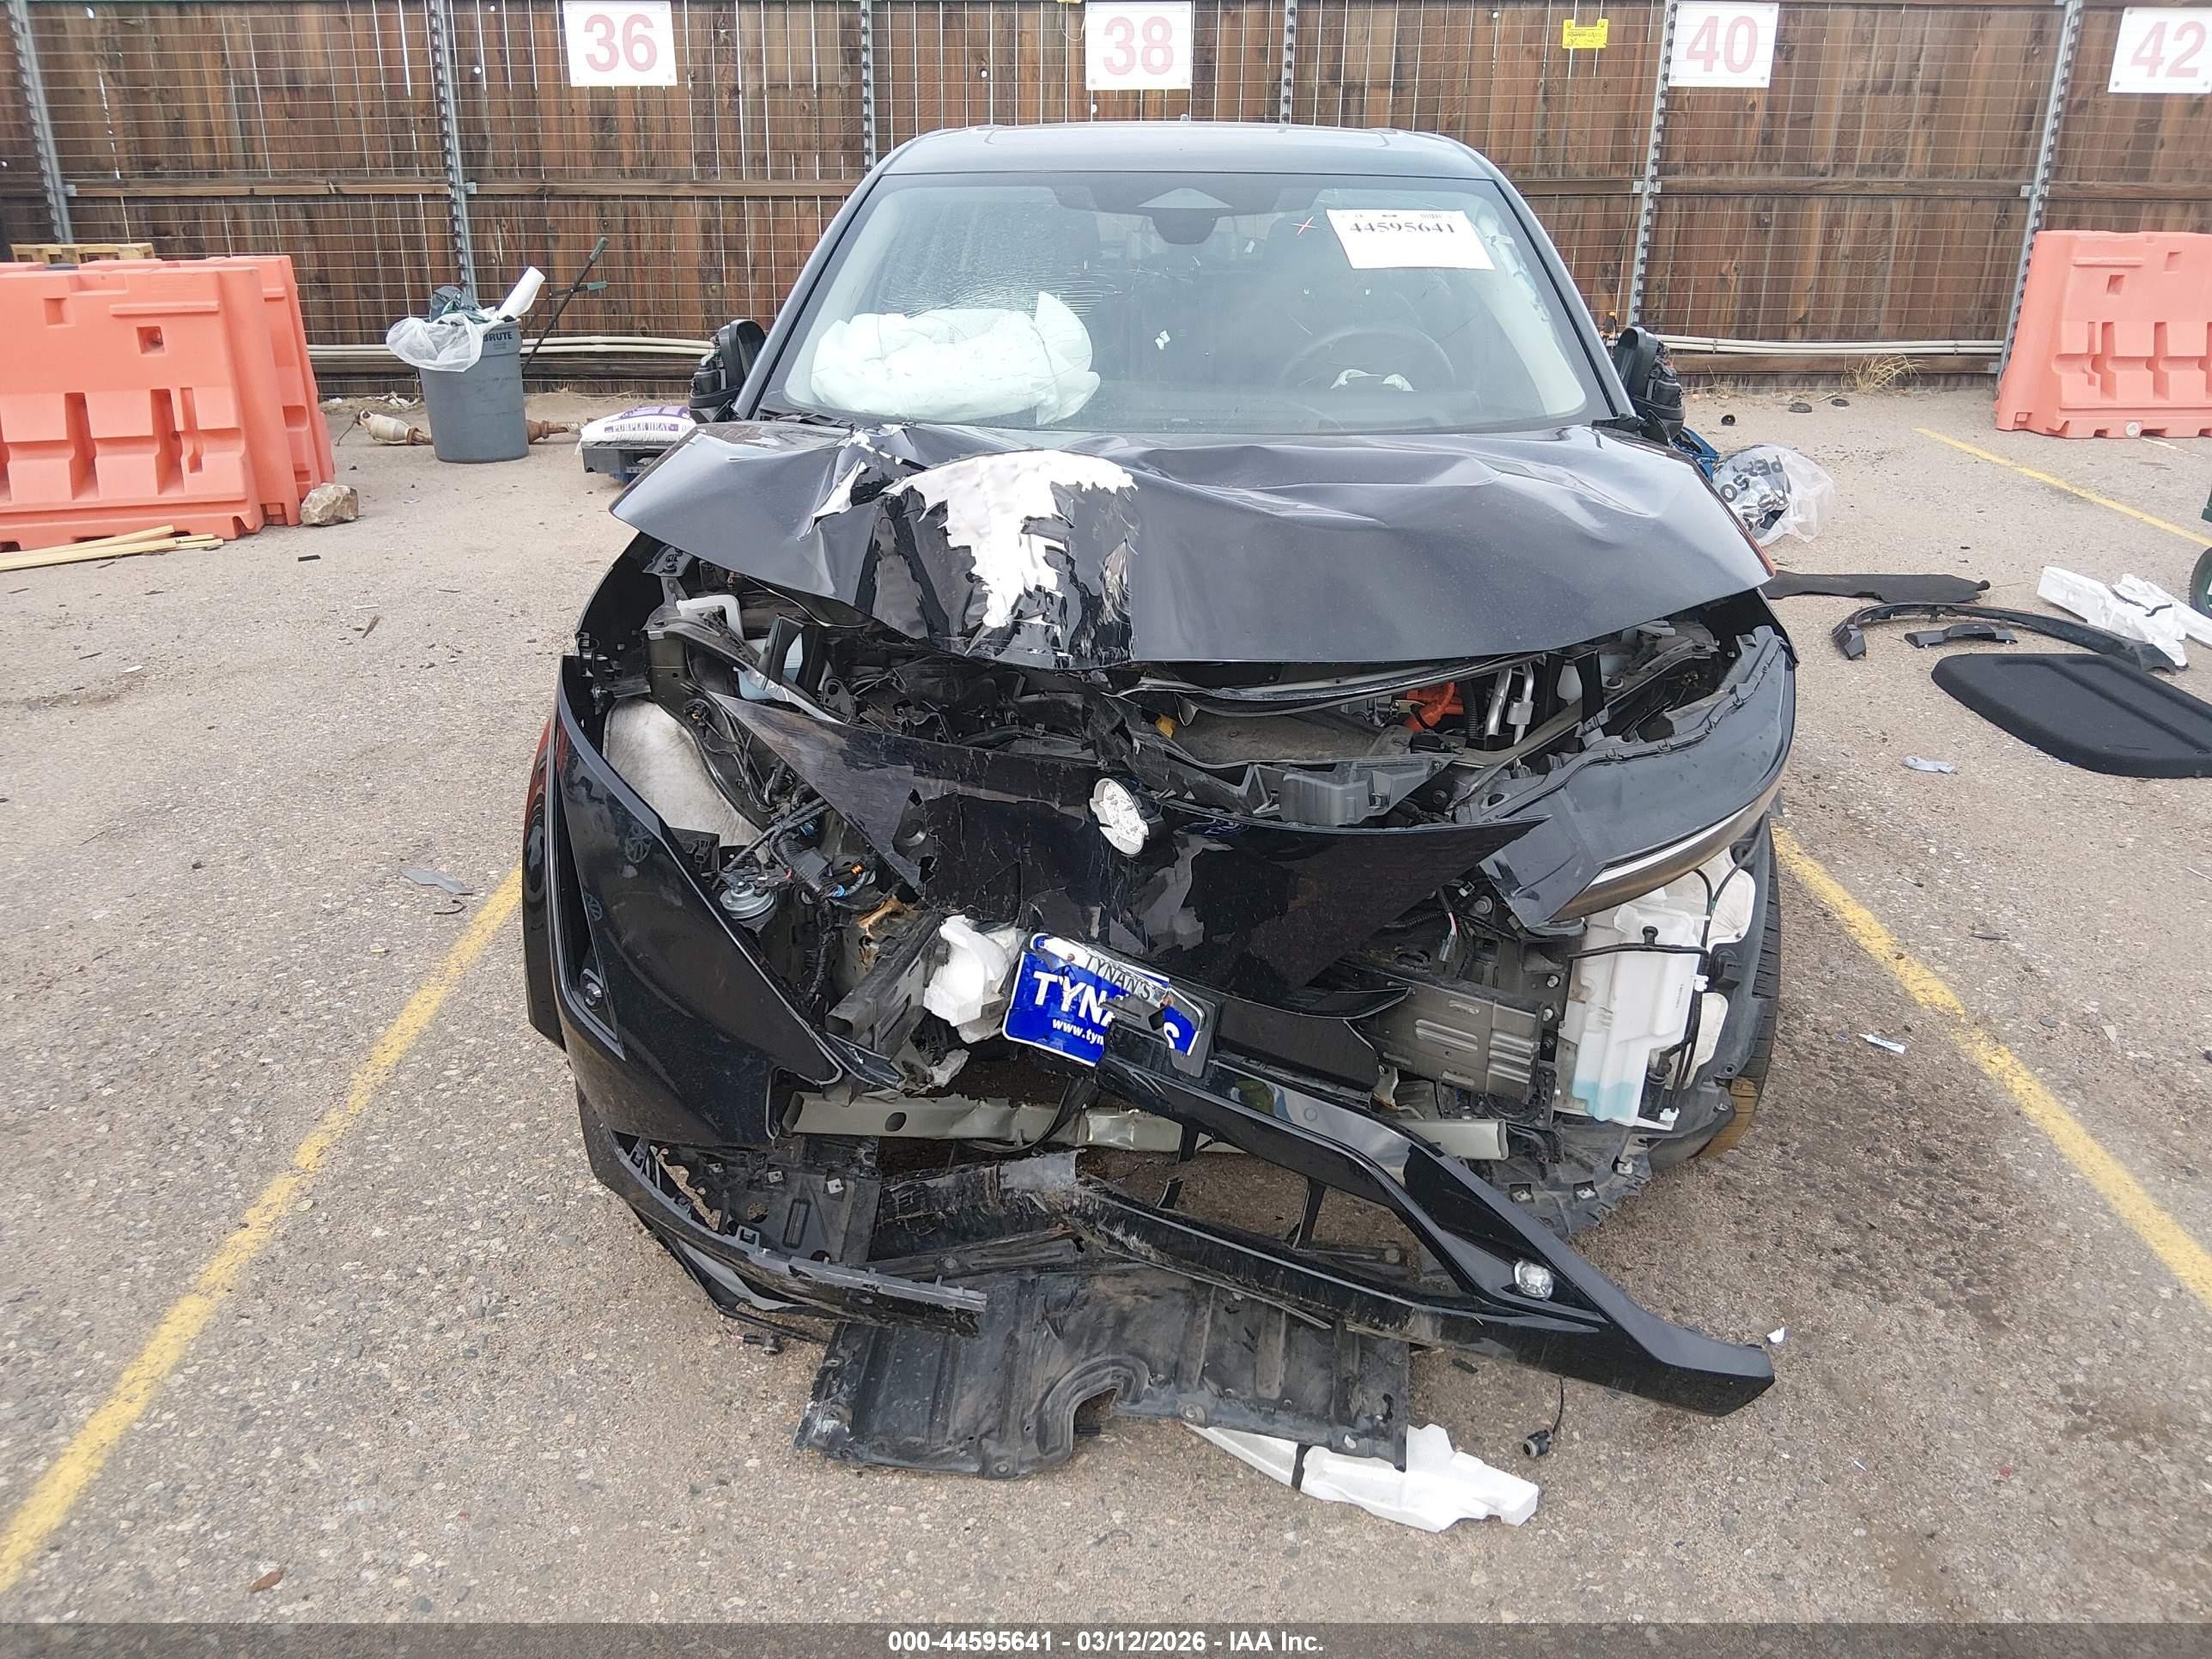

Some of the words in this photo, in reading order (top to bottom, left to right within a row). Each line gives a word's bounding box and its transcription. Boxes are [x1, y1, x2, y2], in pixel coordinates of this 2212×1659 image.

[584, 13, 658, 72] 36
[1103, 15, 1175, 76] 38
[1686, 15, 1759, 74] 40
[2130, 20, 2207, 78] 42
[1349, 222, 1455, 234] 44595641
[483, 331, 514, 343] BRUTE
[647, 422, 670, 432] HEAT
[1085, 952, 1153, 1001] TYNAN'S
